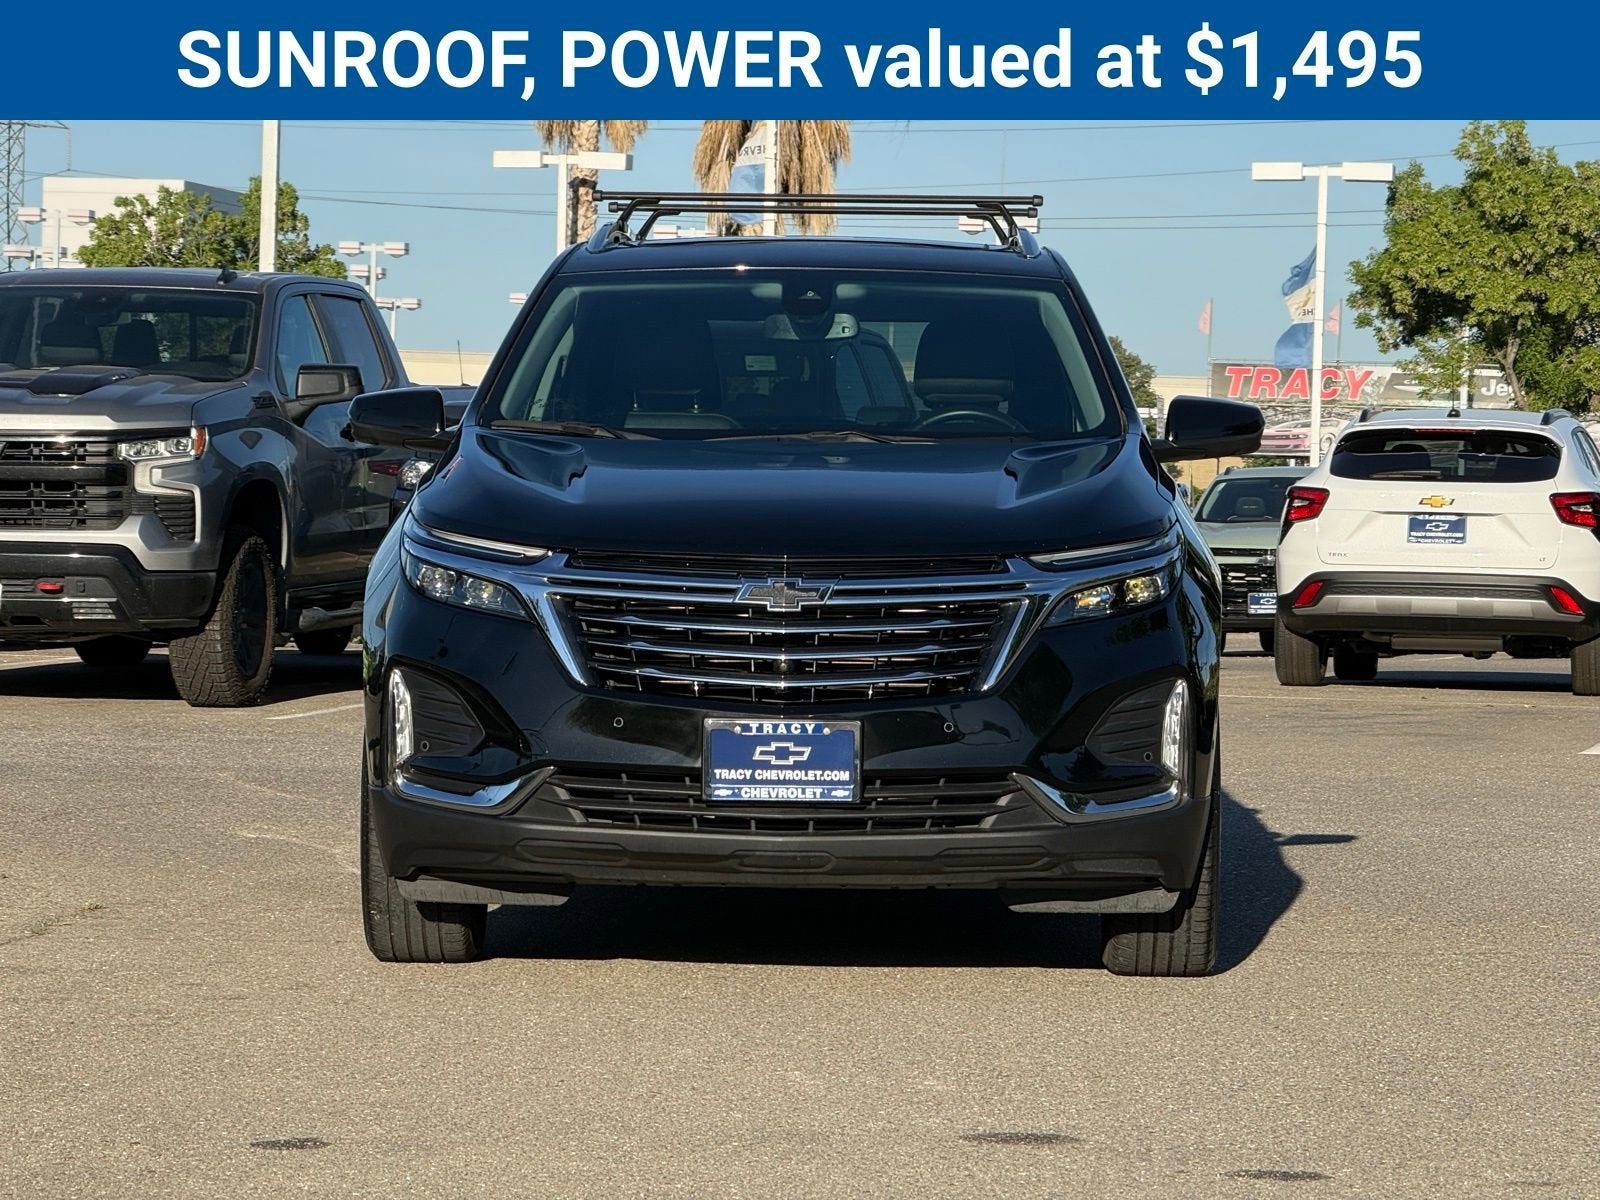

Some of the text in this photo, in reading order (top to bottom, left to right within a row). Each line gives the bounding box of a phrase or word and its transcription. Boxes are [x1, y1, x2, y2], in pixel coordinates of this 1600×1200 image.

[1225, 366, 1376, 400] TRACY
[1480, 379, 1515, 396] Je
[750, 723, 816, 734] TRACY
[714, 769, 850, 781] TRACY CHEVROLET.COM
[741, 787, 823, 799] CHEVROLET
